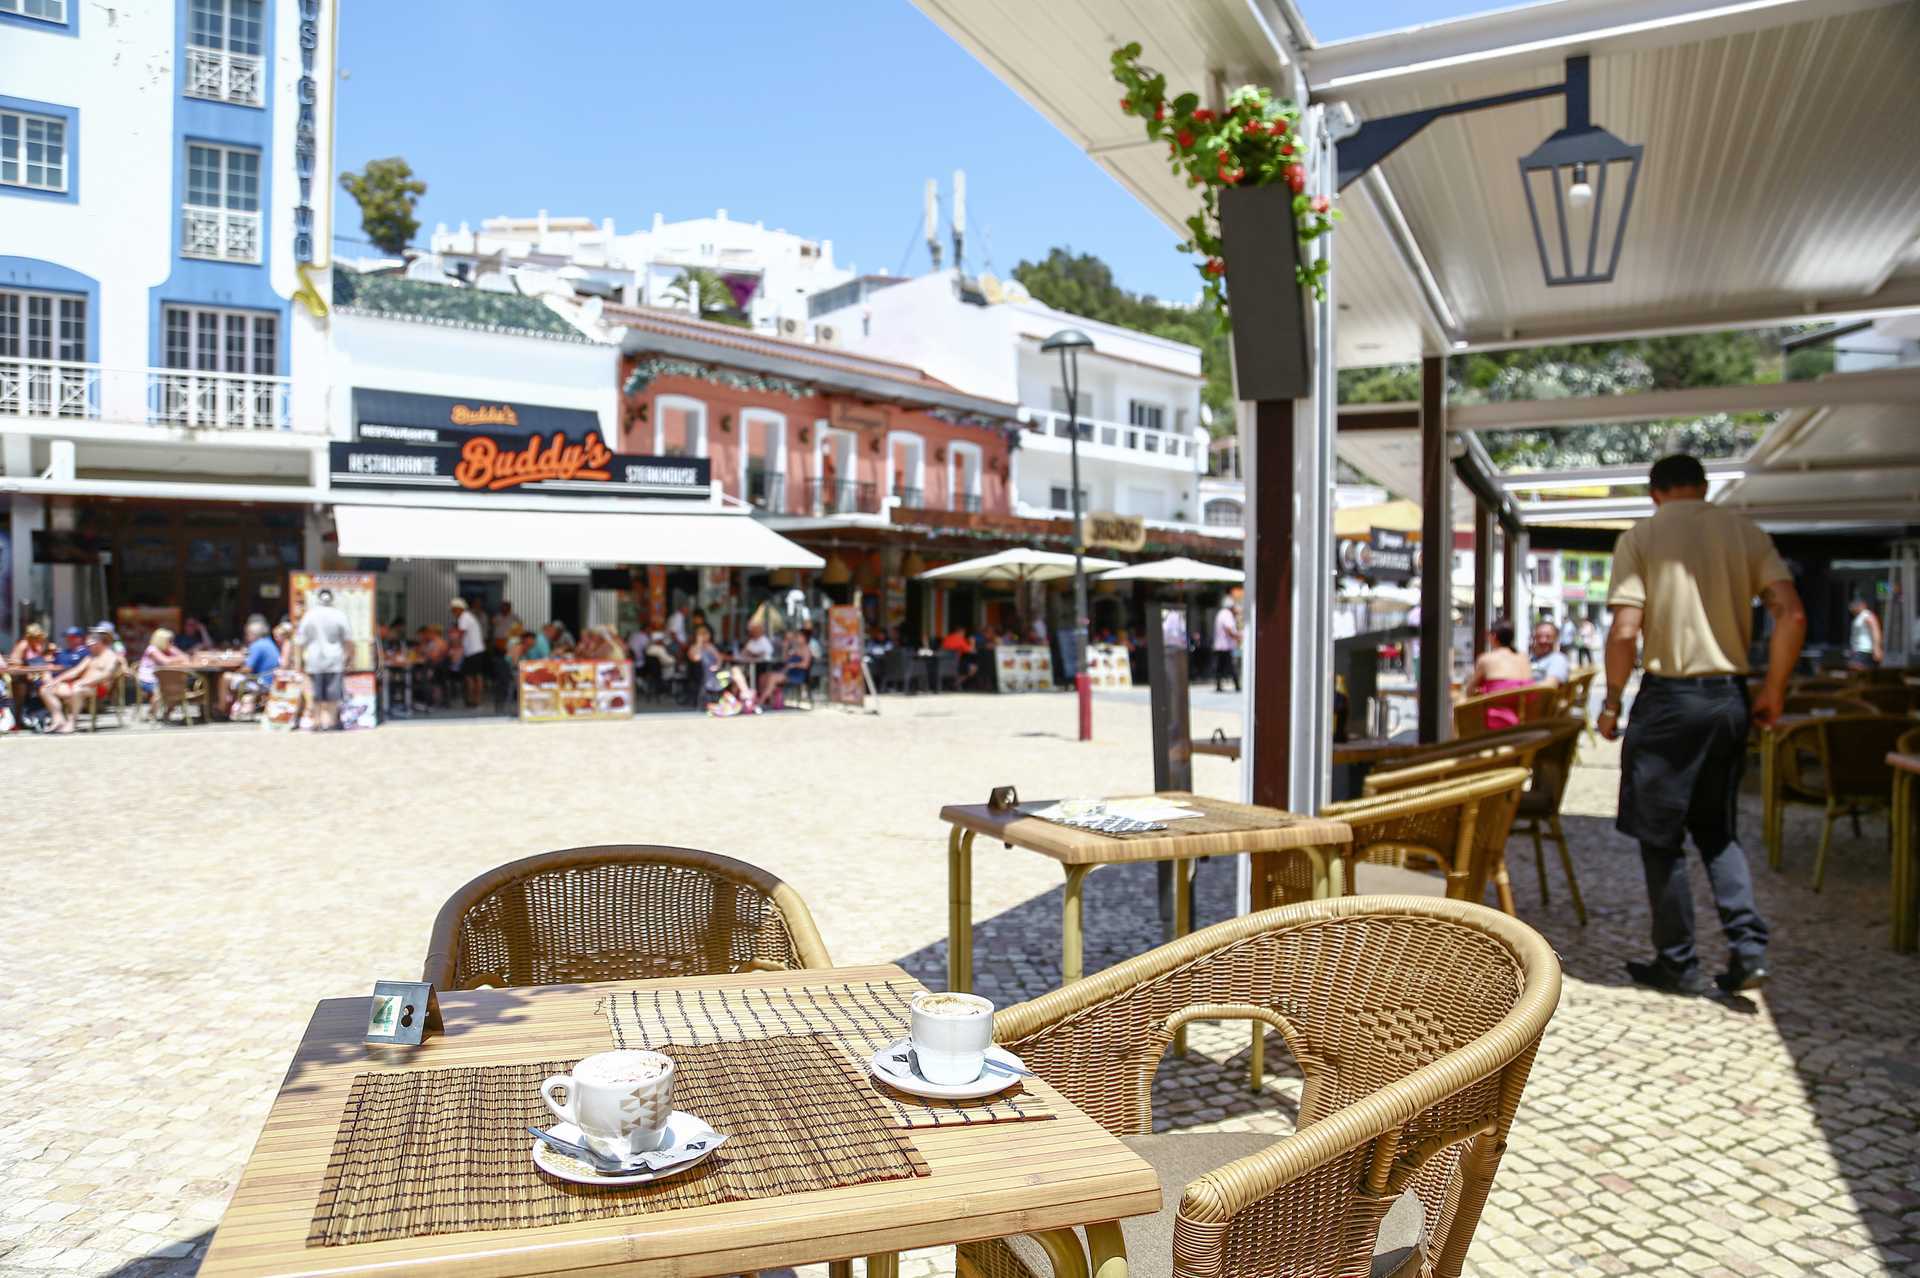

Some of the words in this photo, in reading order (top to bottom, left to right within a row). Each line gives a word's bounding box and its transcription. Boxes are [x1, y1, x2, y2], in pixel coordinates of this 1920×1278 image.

[451, 403, 518, 425] Buddy's
[348, 453, 439, 475] RESTAURANTE
[455, 432, 612, 489] Buddy's
